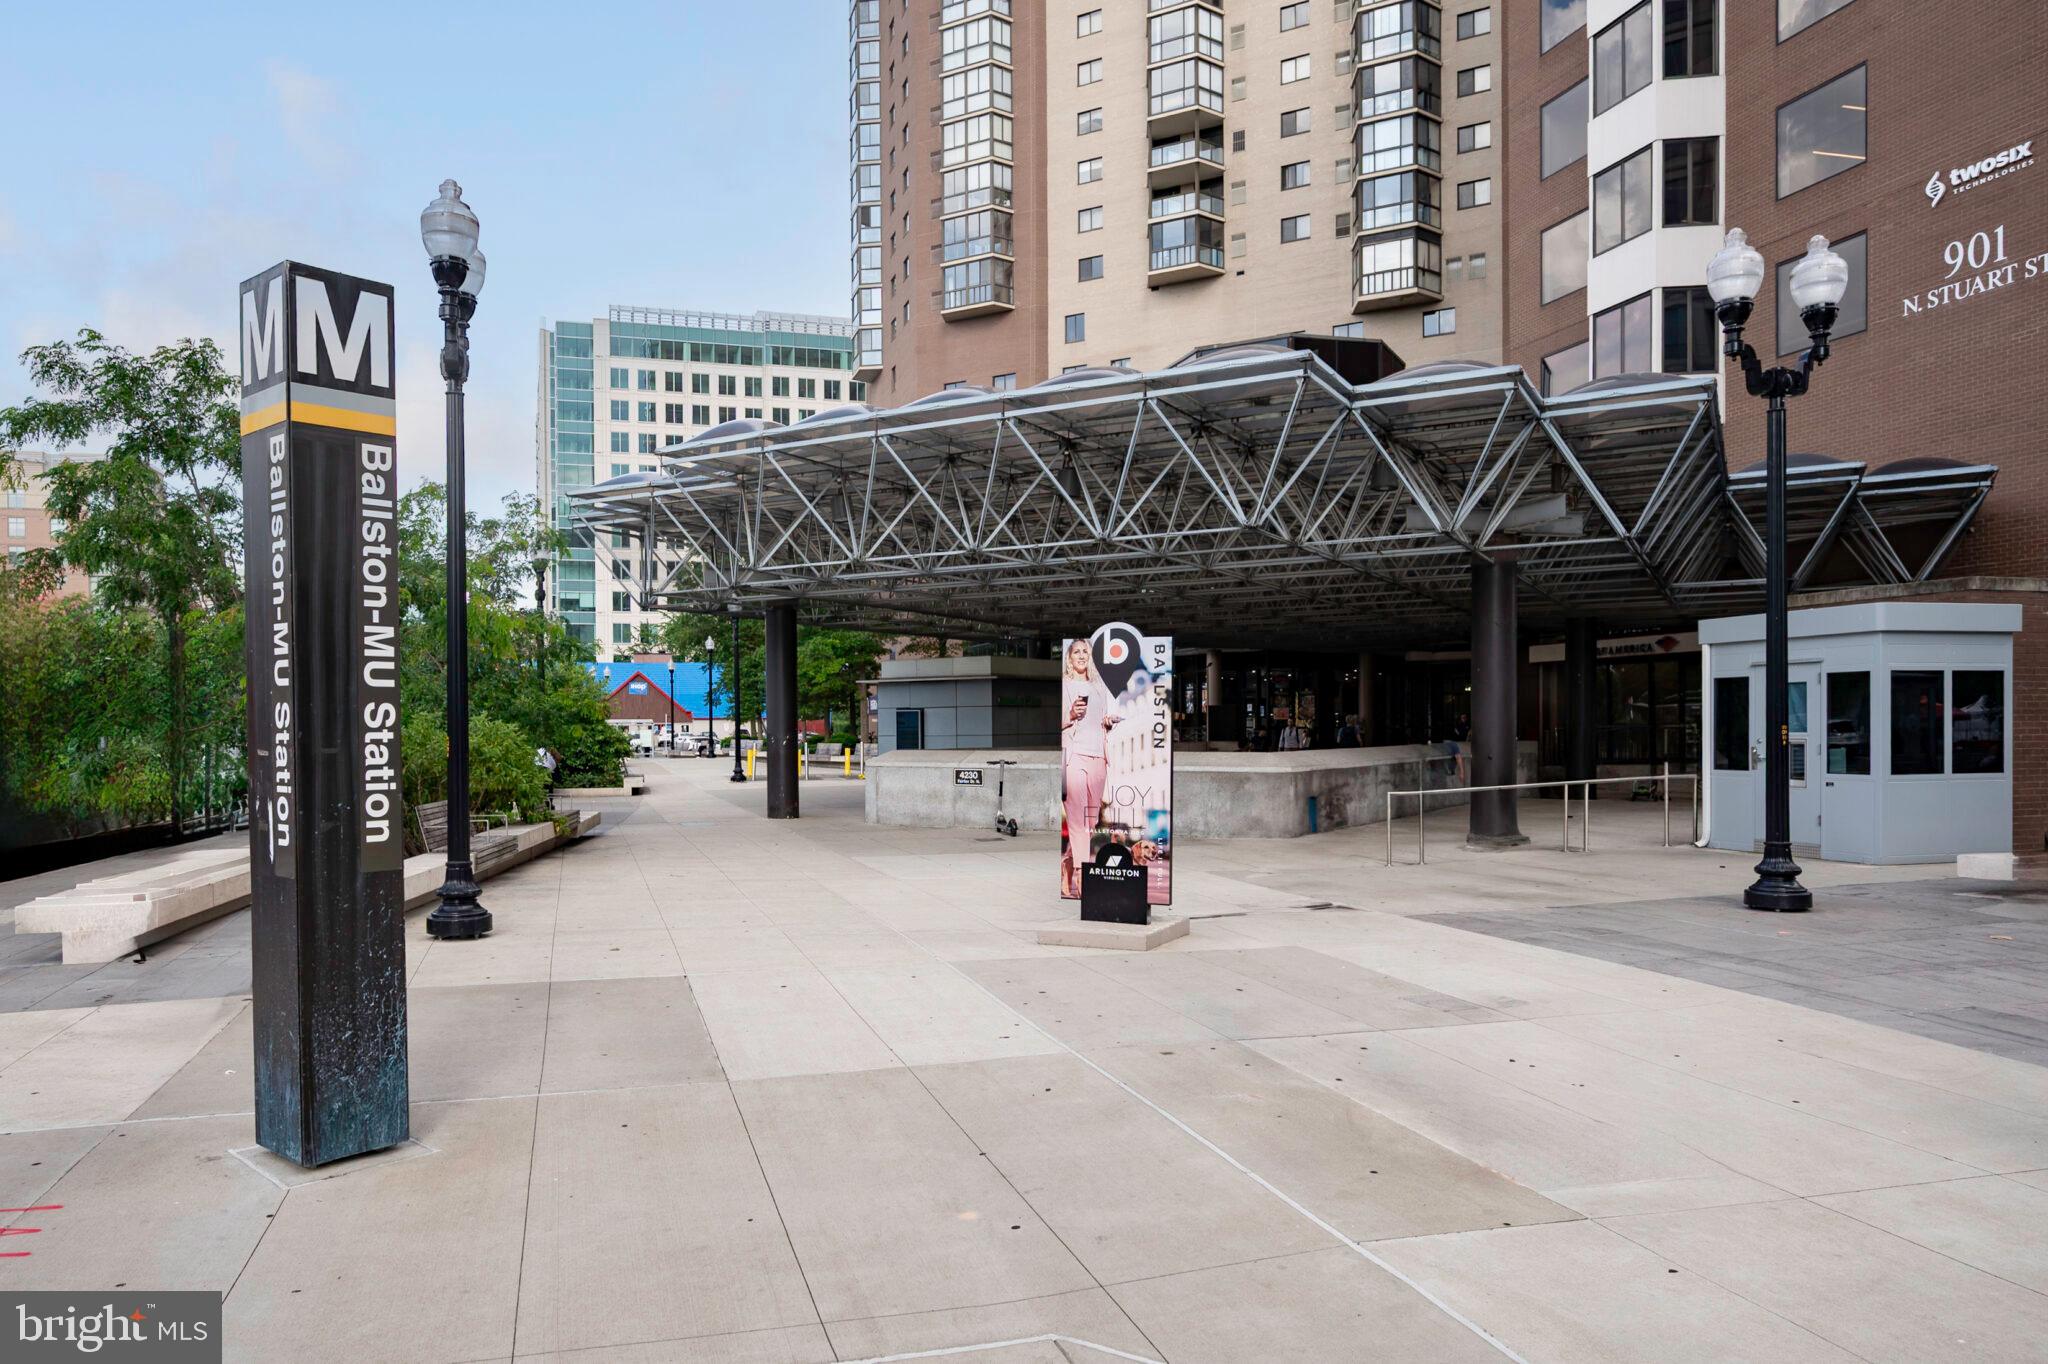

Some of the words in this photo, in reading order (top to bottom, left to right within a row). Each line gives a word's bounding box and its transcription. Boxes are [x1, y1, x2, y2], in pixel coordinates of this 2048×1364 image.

[1950, 141, 2033, 186] twosix
[1953, 159, 2035, 195] TECHNOLOGIES
[1902, 295, 1923, 317] N.
[1927, 262, 2018, 309] STUART
[1944, 224, 2008, 279] 901
[242, 275, 284, 387] M
[295, 275, 390, 388] M
[269, 433, 289, 687] Ballston-MU
[361, 442, 395, 688] Ballston-MU
[1154, 644, 1165, 748] BALLSTON
[274, 702, 292, 847] Station
[363, 701, 396, 843] Station
[960, 771, 978, 779] 4230
[1107, 785, 1152, 806] JOY
[1089, 867, 1140, 877] ARLINGTON
